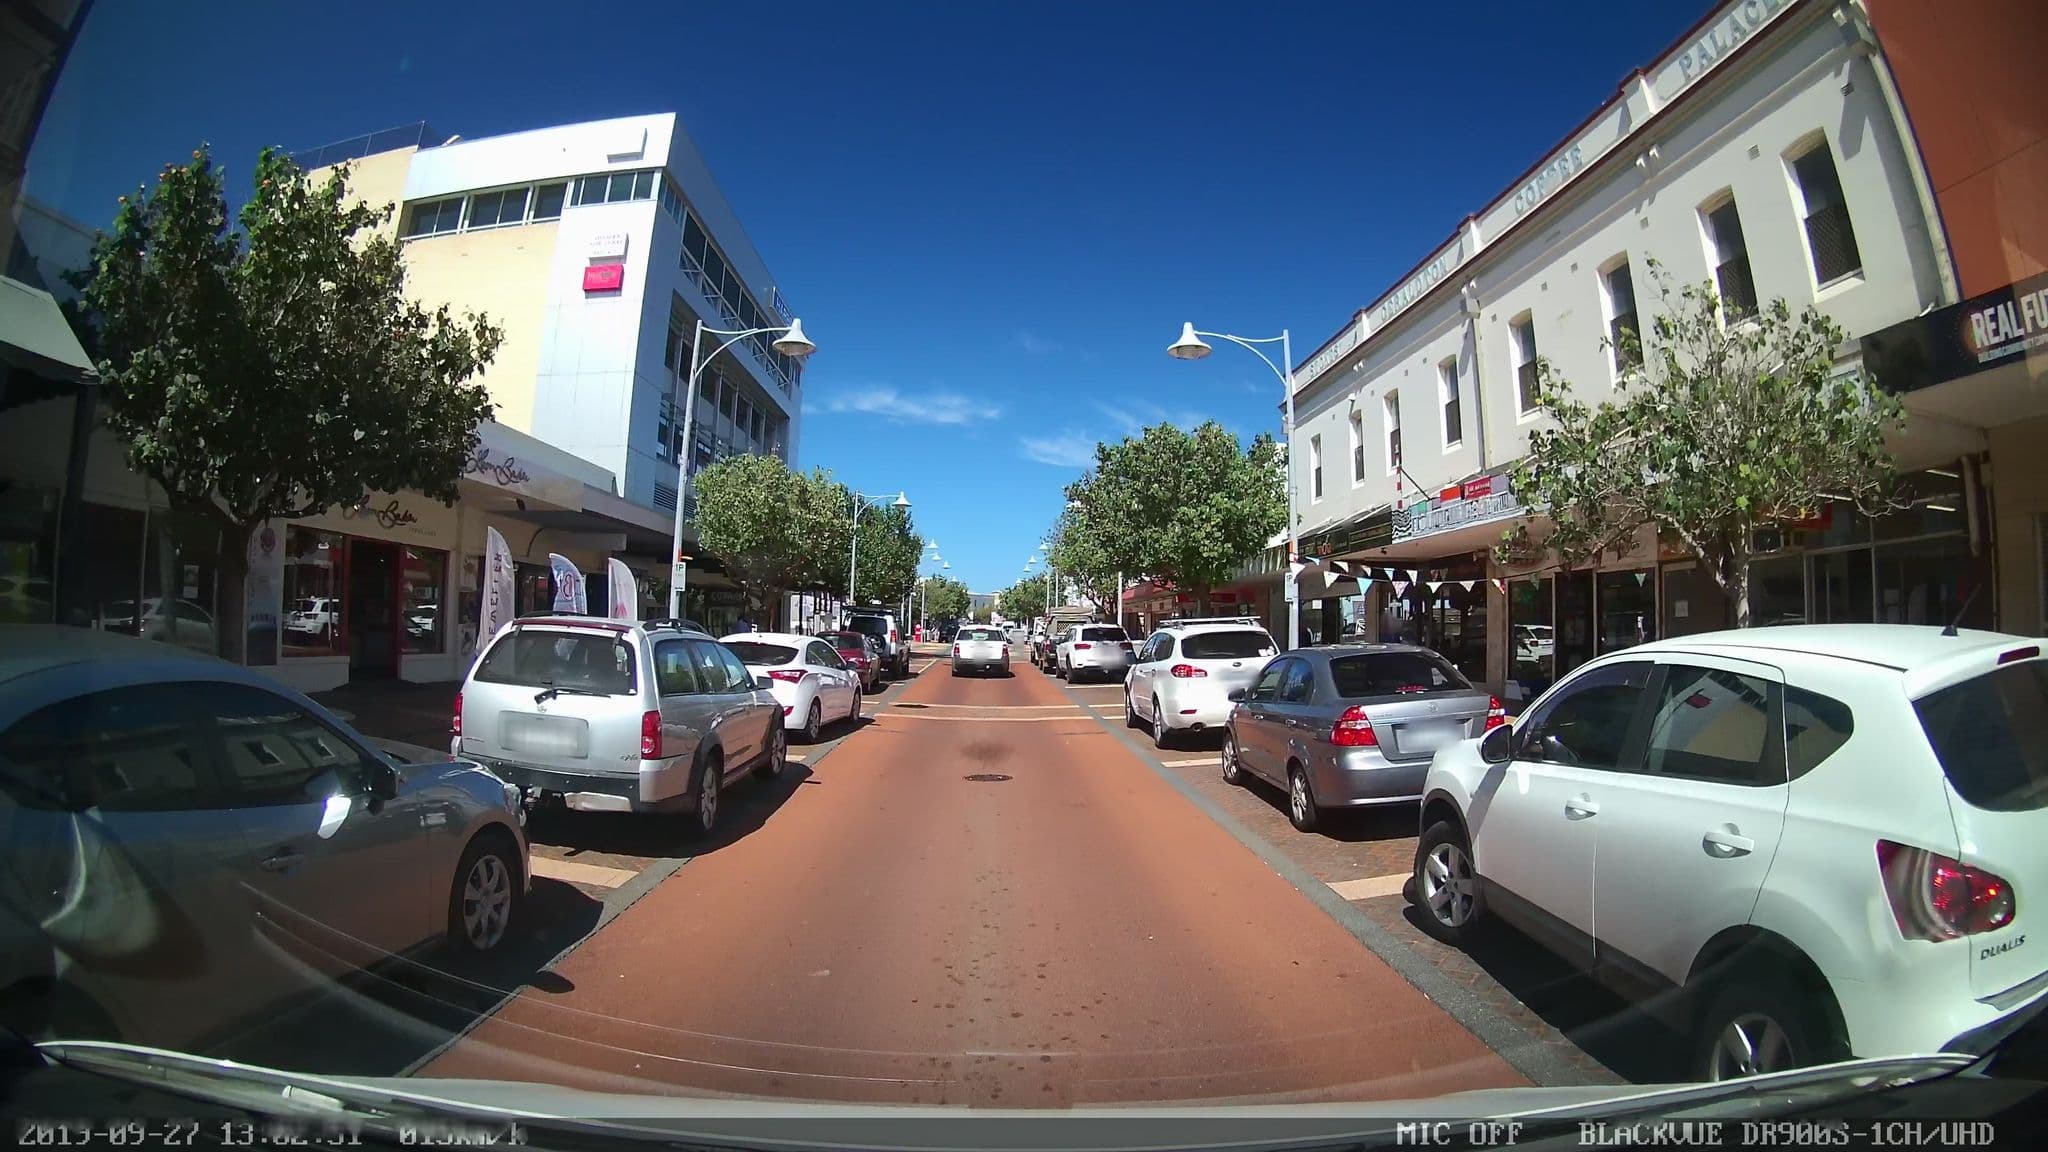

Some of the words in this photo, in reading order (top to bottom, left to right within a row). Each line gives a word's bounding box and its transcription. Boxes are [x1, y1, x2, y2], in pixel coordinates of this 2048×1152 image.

[1514, 144, 1583, 216] COFFEE
[1970, 300, 2025, 349] REAL
[2020, 287, 2048, 333] FU
[1980, 935, 2026, 960] DUALIS
